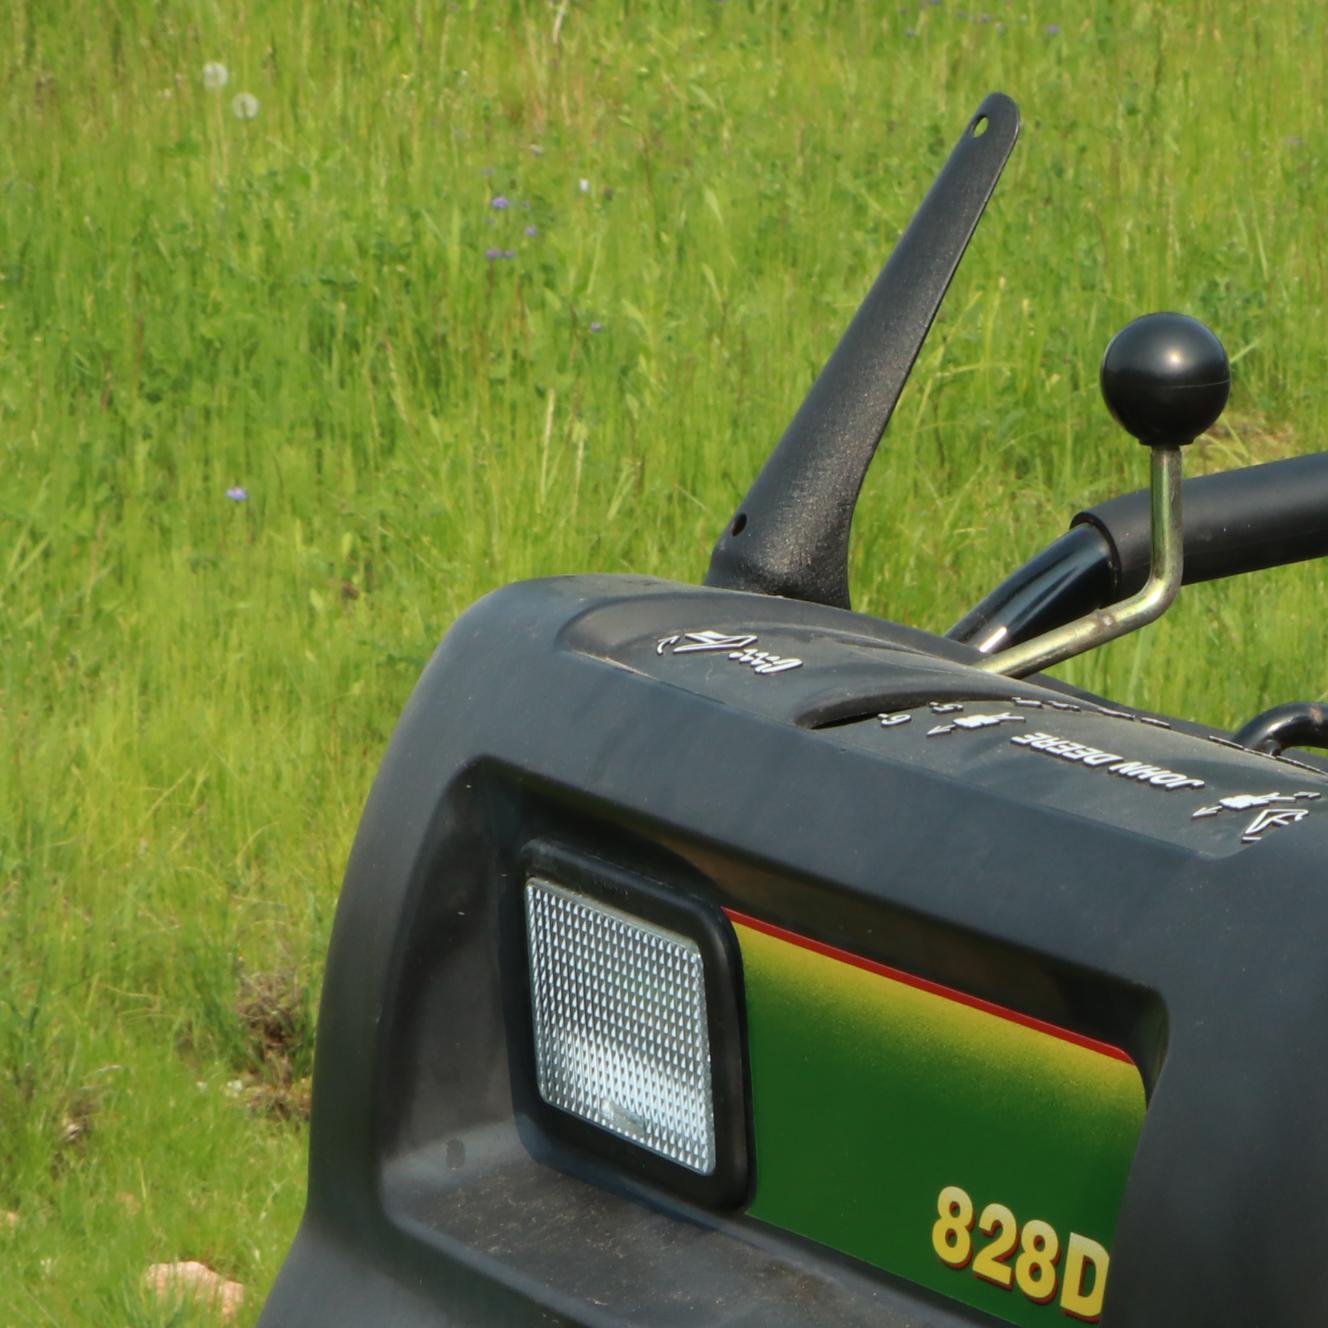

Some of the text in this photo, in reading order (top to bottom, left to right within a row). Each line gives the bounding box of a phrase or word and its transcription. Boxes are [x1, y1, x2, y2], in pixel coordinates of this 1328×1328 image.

[1010, 731, 1205, 790] JOHN DEERE
[931, 1185, 1111, 1325] 828D
